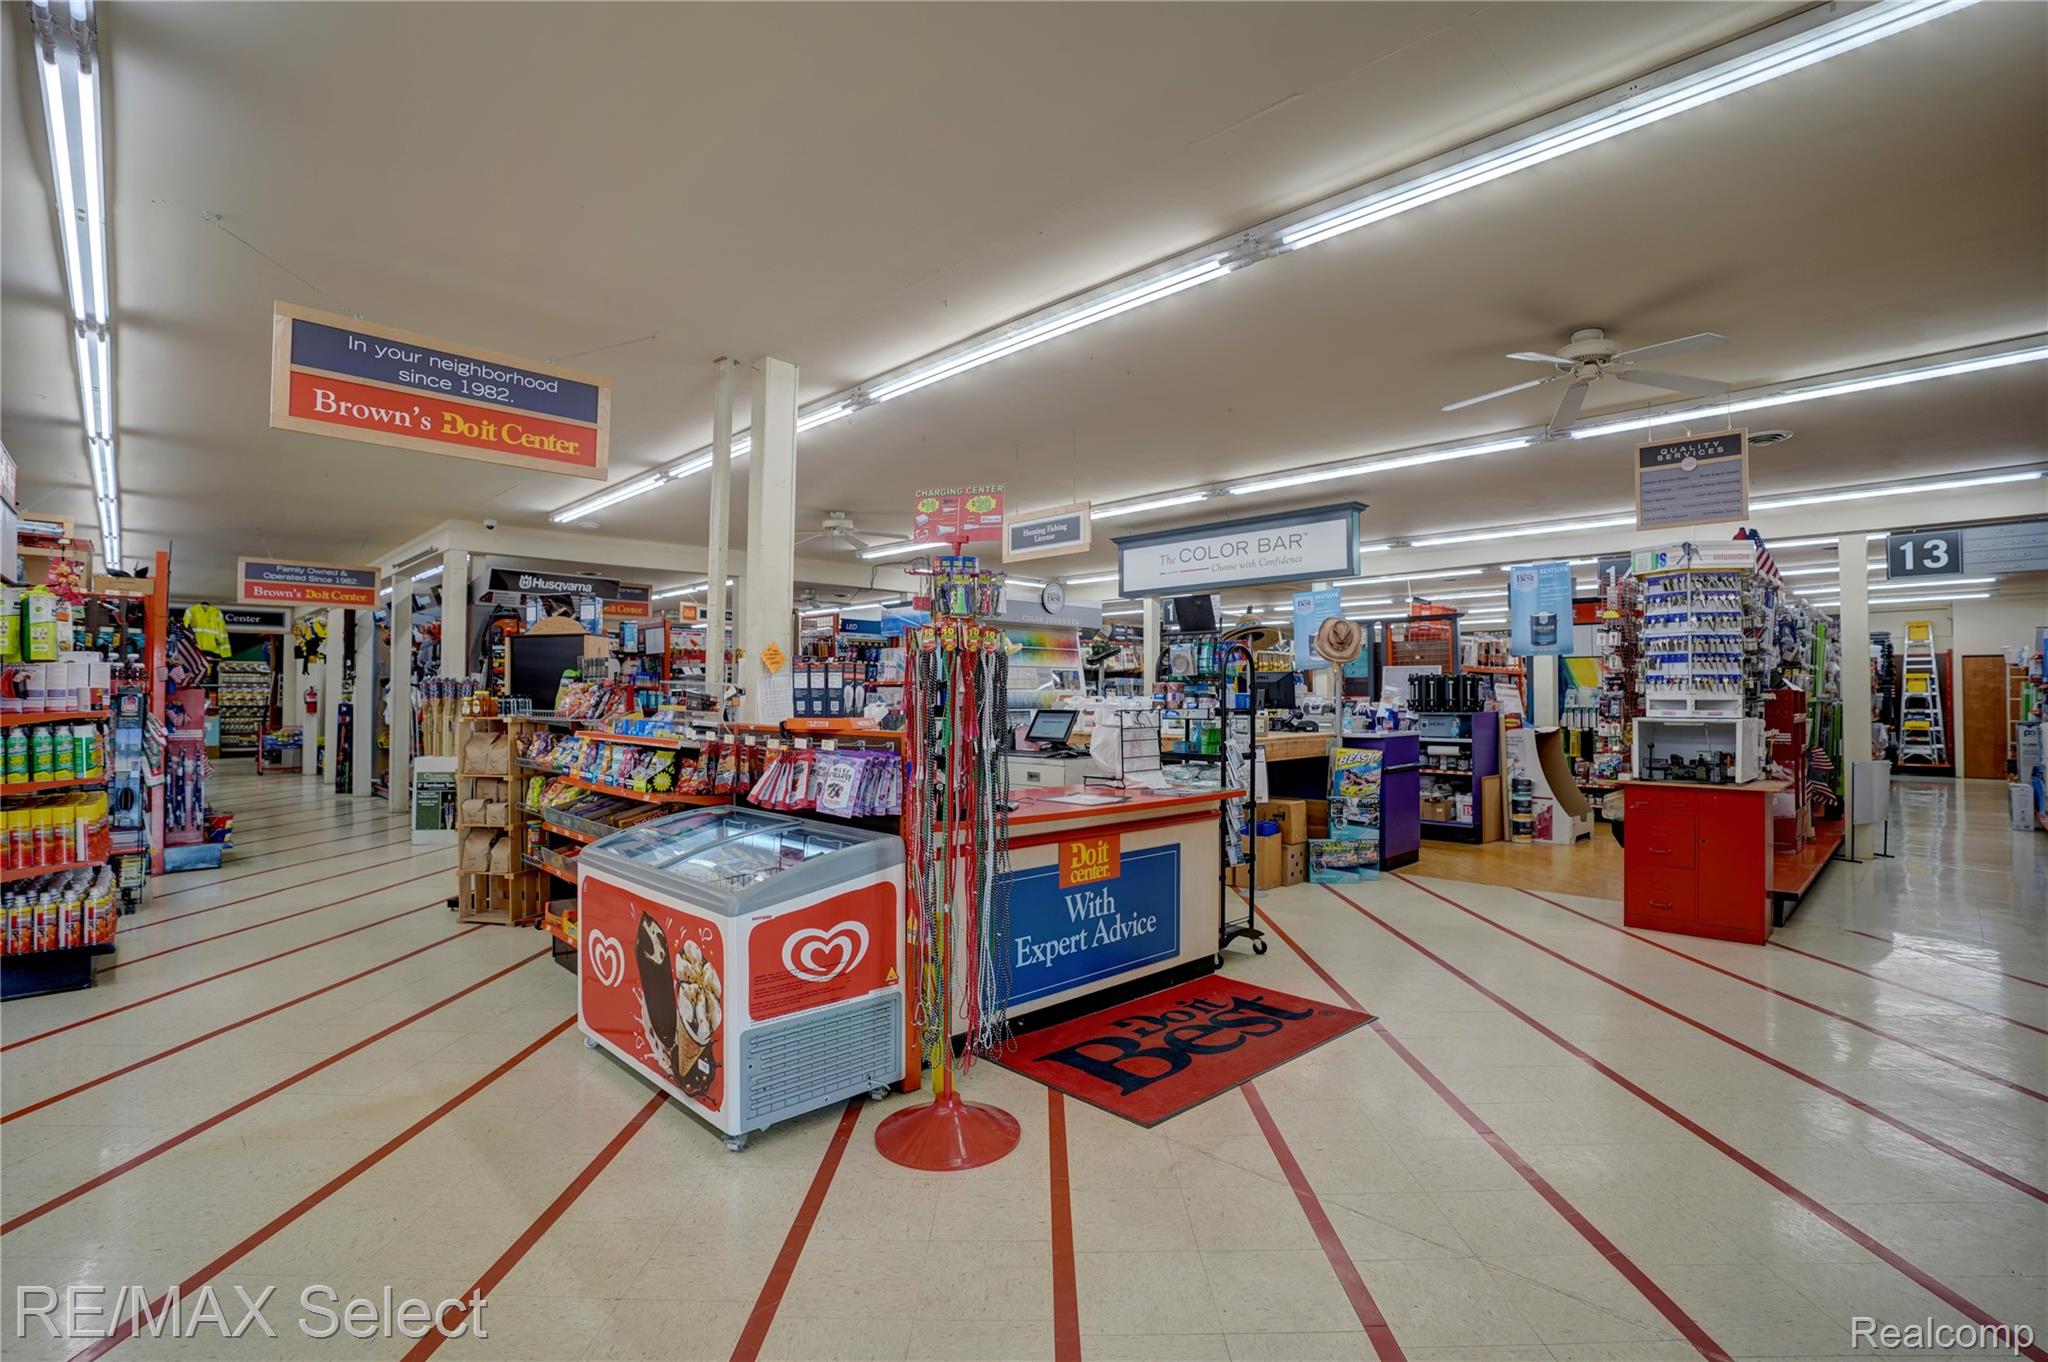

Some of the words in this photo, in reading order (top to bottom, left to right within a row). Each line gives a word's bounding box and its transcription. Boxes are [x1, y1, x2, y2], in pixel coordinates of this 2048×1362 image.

[349, 335, 367, 354] In
[375, 343, 423, 364] your
[430, 355, 558, 394] neighborhood
[398, 368, 452, 391] since
[461, 379, 515, 403] 1982.
[313, 387, 432, 432] Brown's
[1657, 446, 1724, 462] SERVICES
[1660, 441, 1720, 455] QUALITY
[916, 487, 963, 497] CHARGING
[966, 485, 1004, 494] CENTER
[1023, 528, 1046, 538] Hunting
[1046, 523, 1068, 533] Fishing
[1034, 534, 1056, 543] License
[1159, 553, 1176, 566] The
[1179, 540, 1249, 564] COLOR
[1899, 539, 1949, 571] 13
[276, 564, 305, 575] Family
[307, 566, 338, 577] Owned
[340, 569, 348, 577] &
[1211, 561, 1238, 573] Choose
[1240, 557, 1256, 569] with
[1258, 554, 1303, 568] Confidence
[263, 571, 306, 583] Operated
[308, 573, 332, 584] Since
[532, 576, 592, 594] Husqvarna
[253, 586, 301, 599] Brown's
[331, 590, 367, 602] Center
[617, 604, 643, 614] Center
[225, 613, 261, 623] Center
[1064, 886, 1116, 923] With
[1015, 929, 1088, 968] Expert
[1092, 911, 1157, 948] Advice
[1032, 995, 1314, 1097] Best
